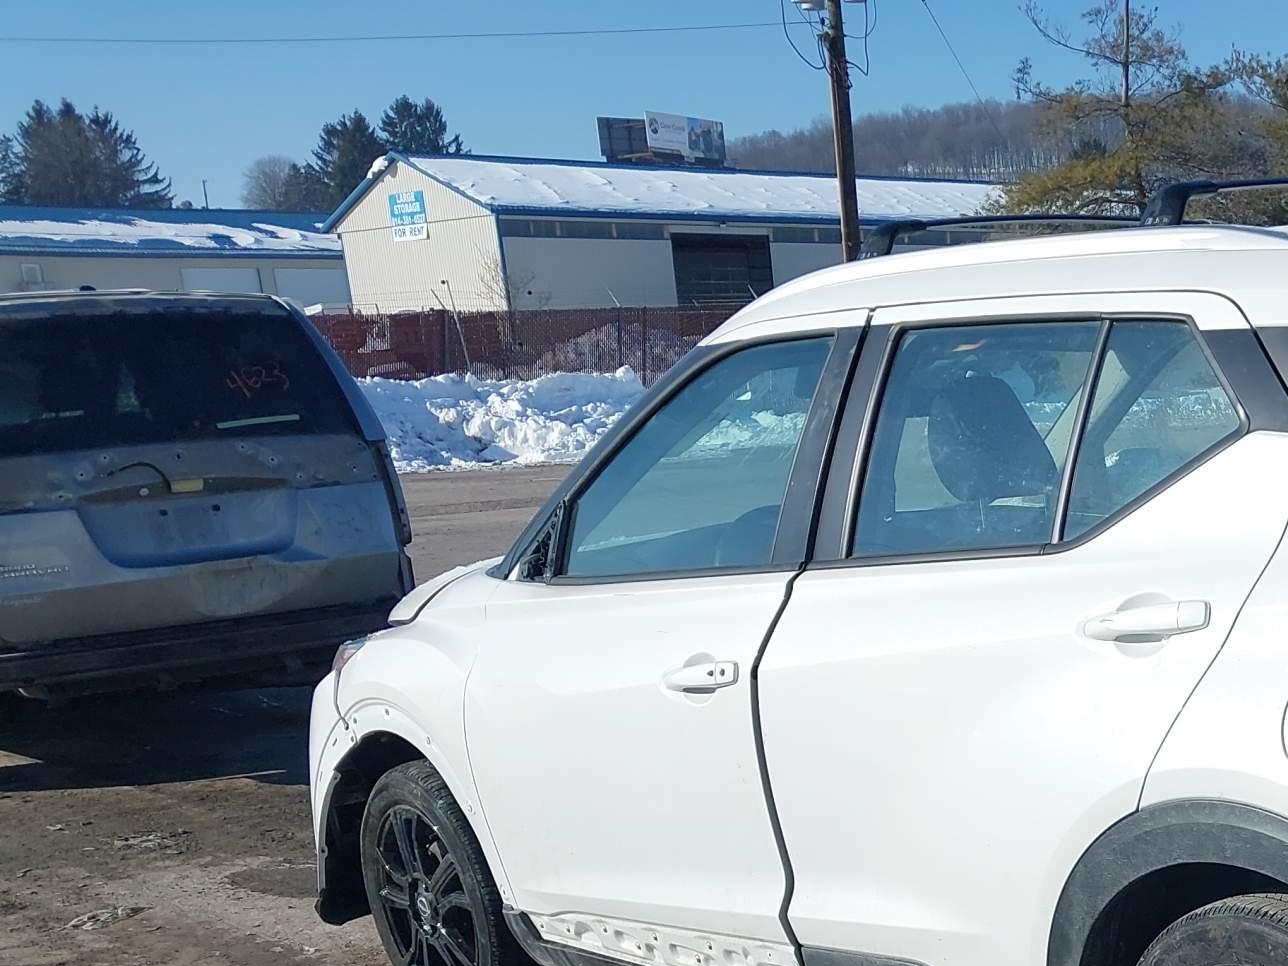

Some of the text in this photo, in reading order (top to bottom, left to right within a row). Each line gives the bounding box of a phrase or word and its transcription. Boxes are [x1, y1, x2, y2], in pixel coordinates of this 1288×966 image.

[396, 191, 415, 203] LARGE
[394, 202, 420, 214] STORAGE
[394, 226, 425, 238] FOR RENT
